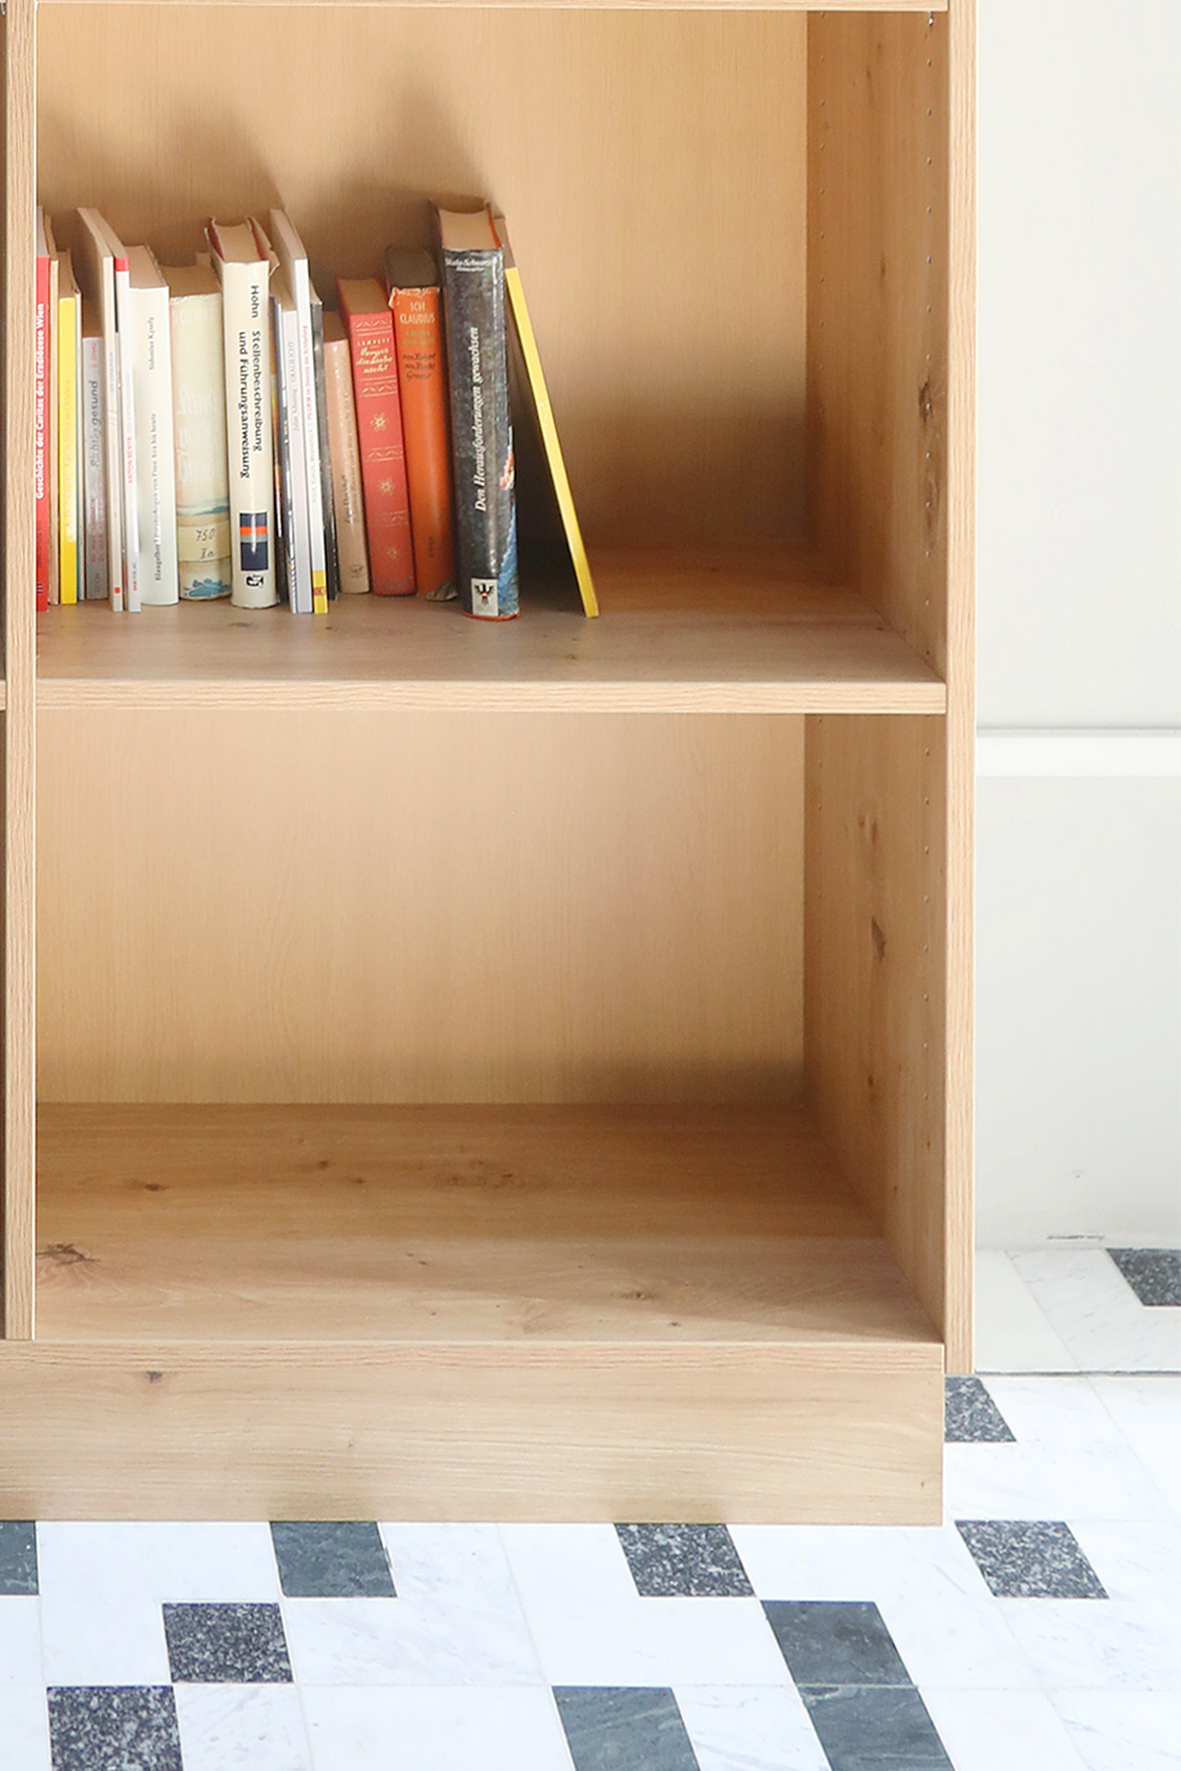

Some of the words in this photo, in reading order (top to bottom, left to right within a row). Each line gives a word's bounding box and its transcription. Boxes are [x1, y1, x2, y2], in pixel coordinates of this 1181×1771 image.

[239, 332, 247, 355] und
[467, 327, 484, 384] gewachsen
[239, 357, 251, 478] Führungsanweisung
[250, 330, 263, 452] Stellenbeschreibung
[471, 386, 487, 486] Herausforderungen
[474, 489, 486, 512] Den
